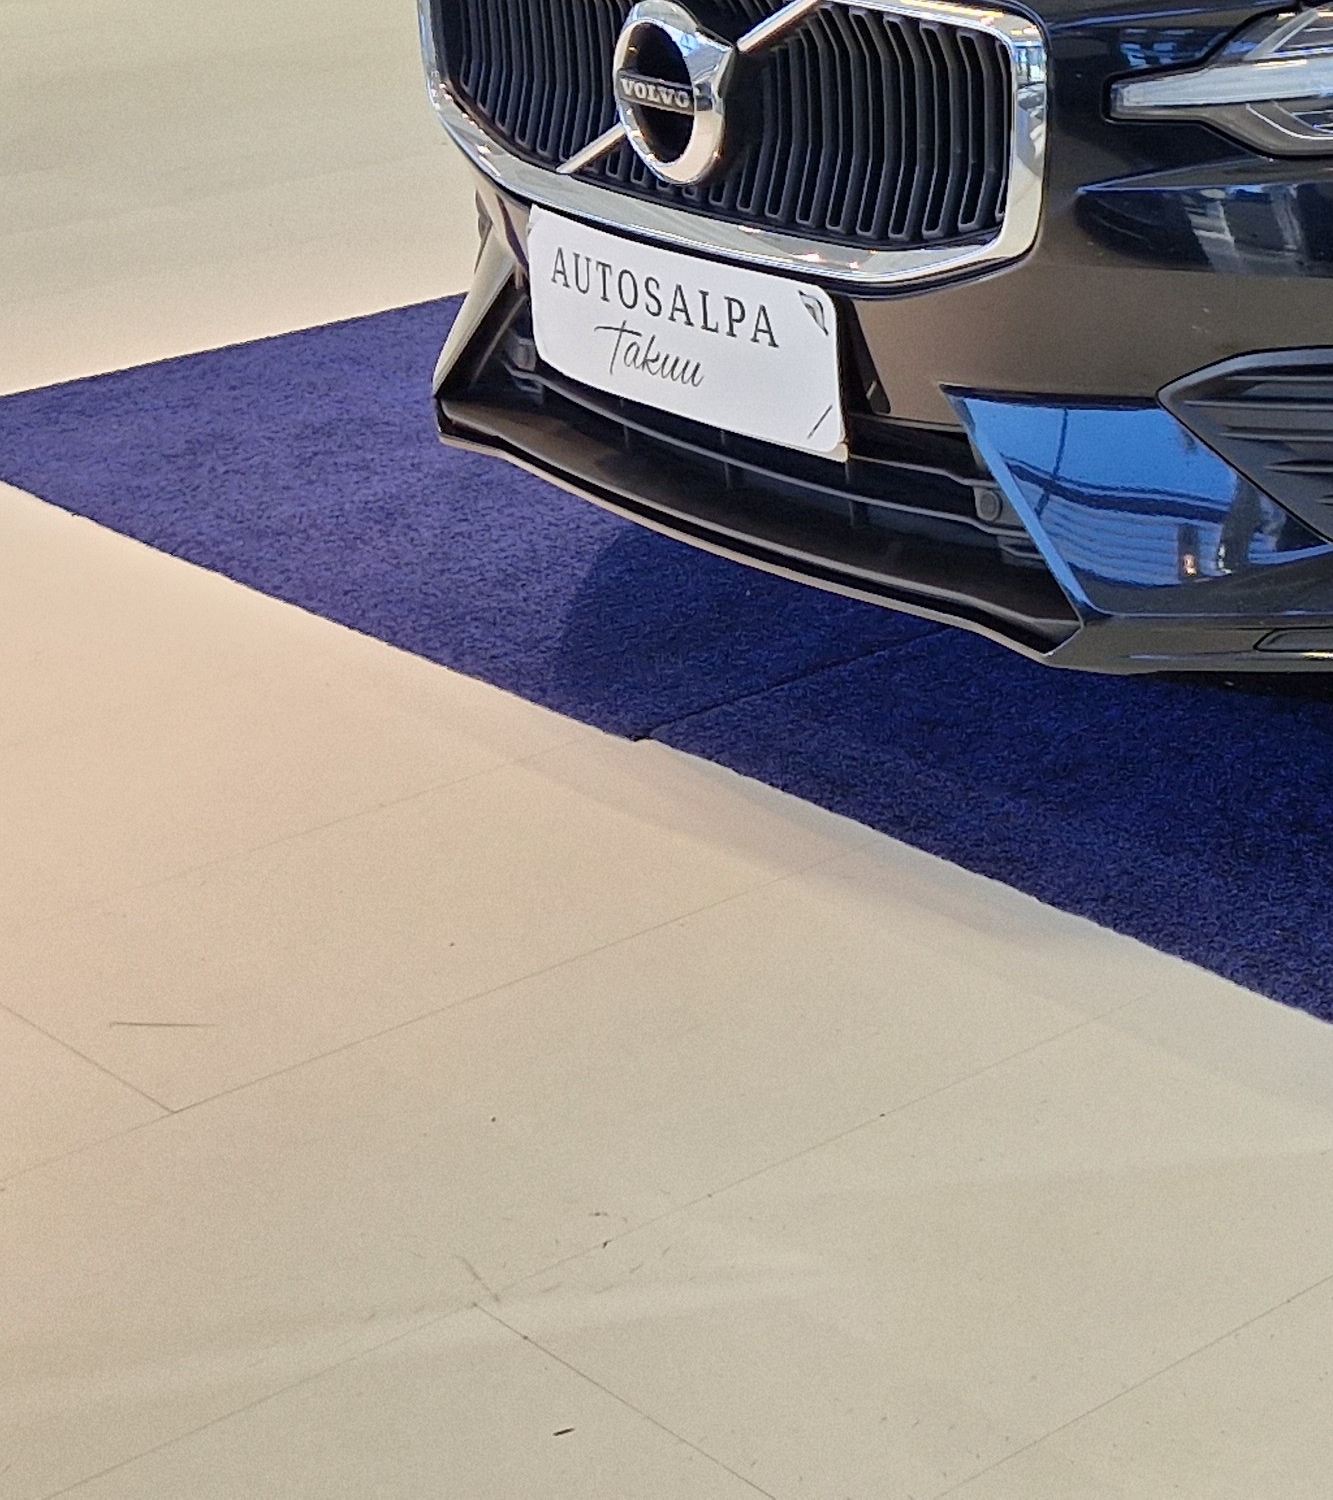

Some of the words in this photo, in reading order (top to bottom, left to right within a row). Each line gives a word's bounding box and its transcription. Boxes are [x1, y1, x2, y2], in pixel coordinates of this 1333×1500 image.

[620, 78, 690, 108] VOLVO
[551, 247, 780, 348] AUTOSALPA
[594, 320, 705, 388] Takuu
